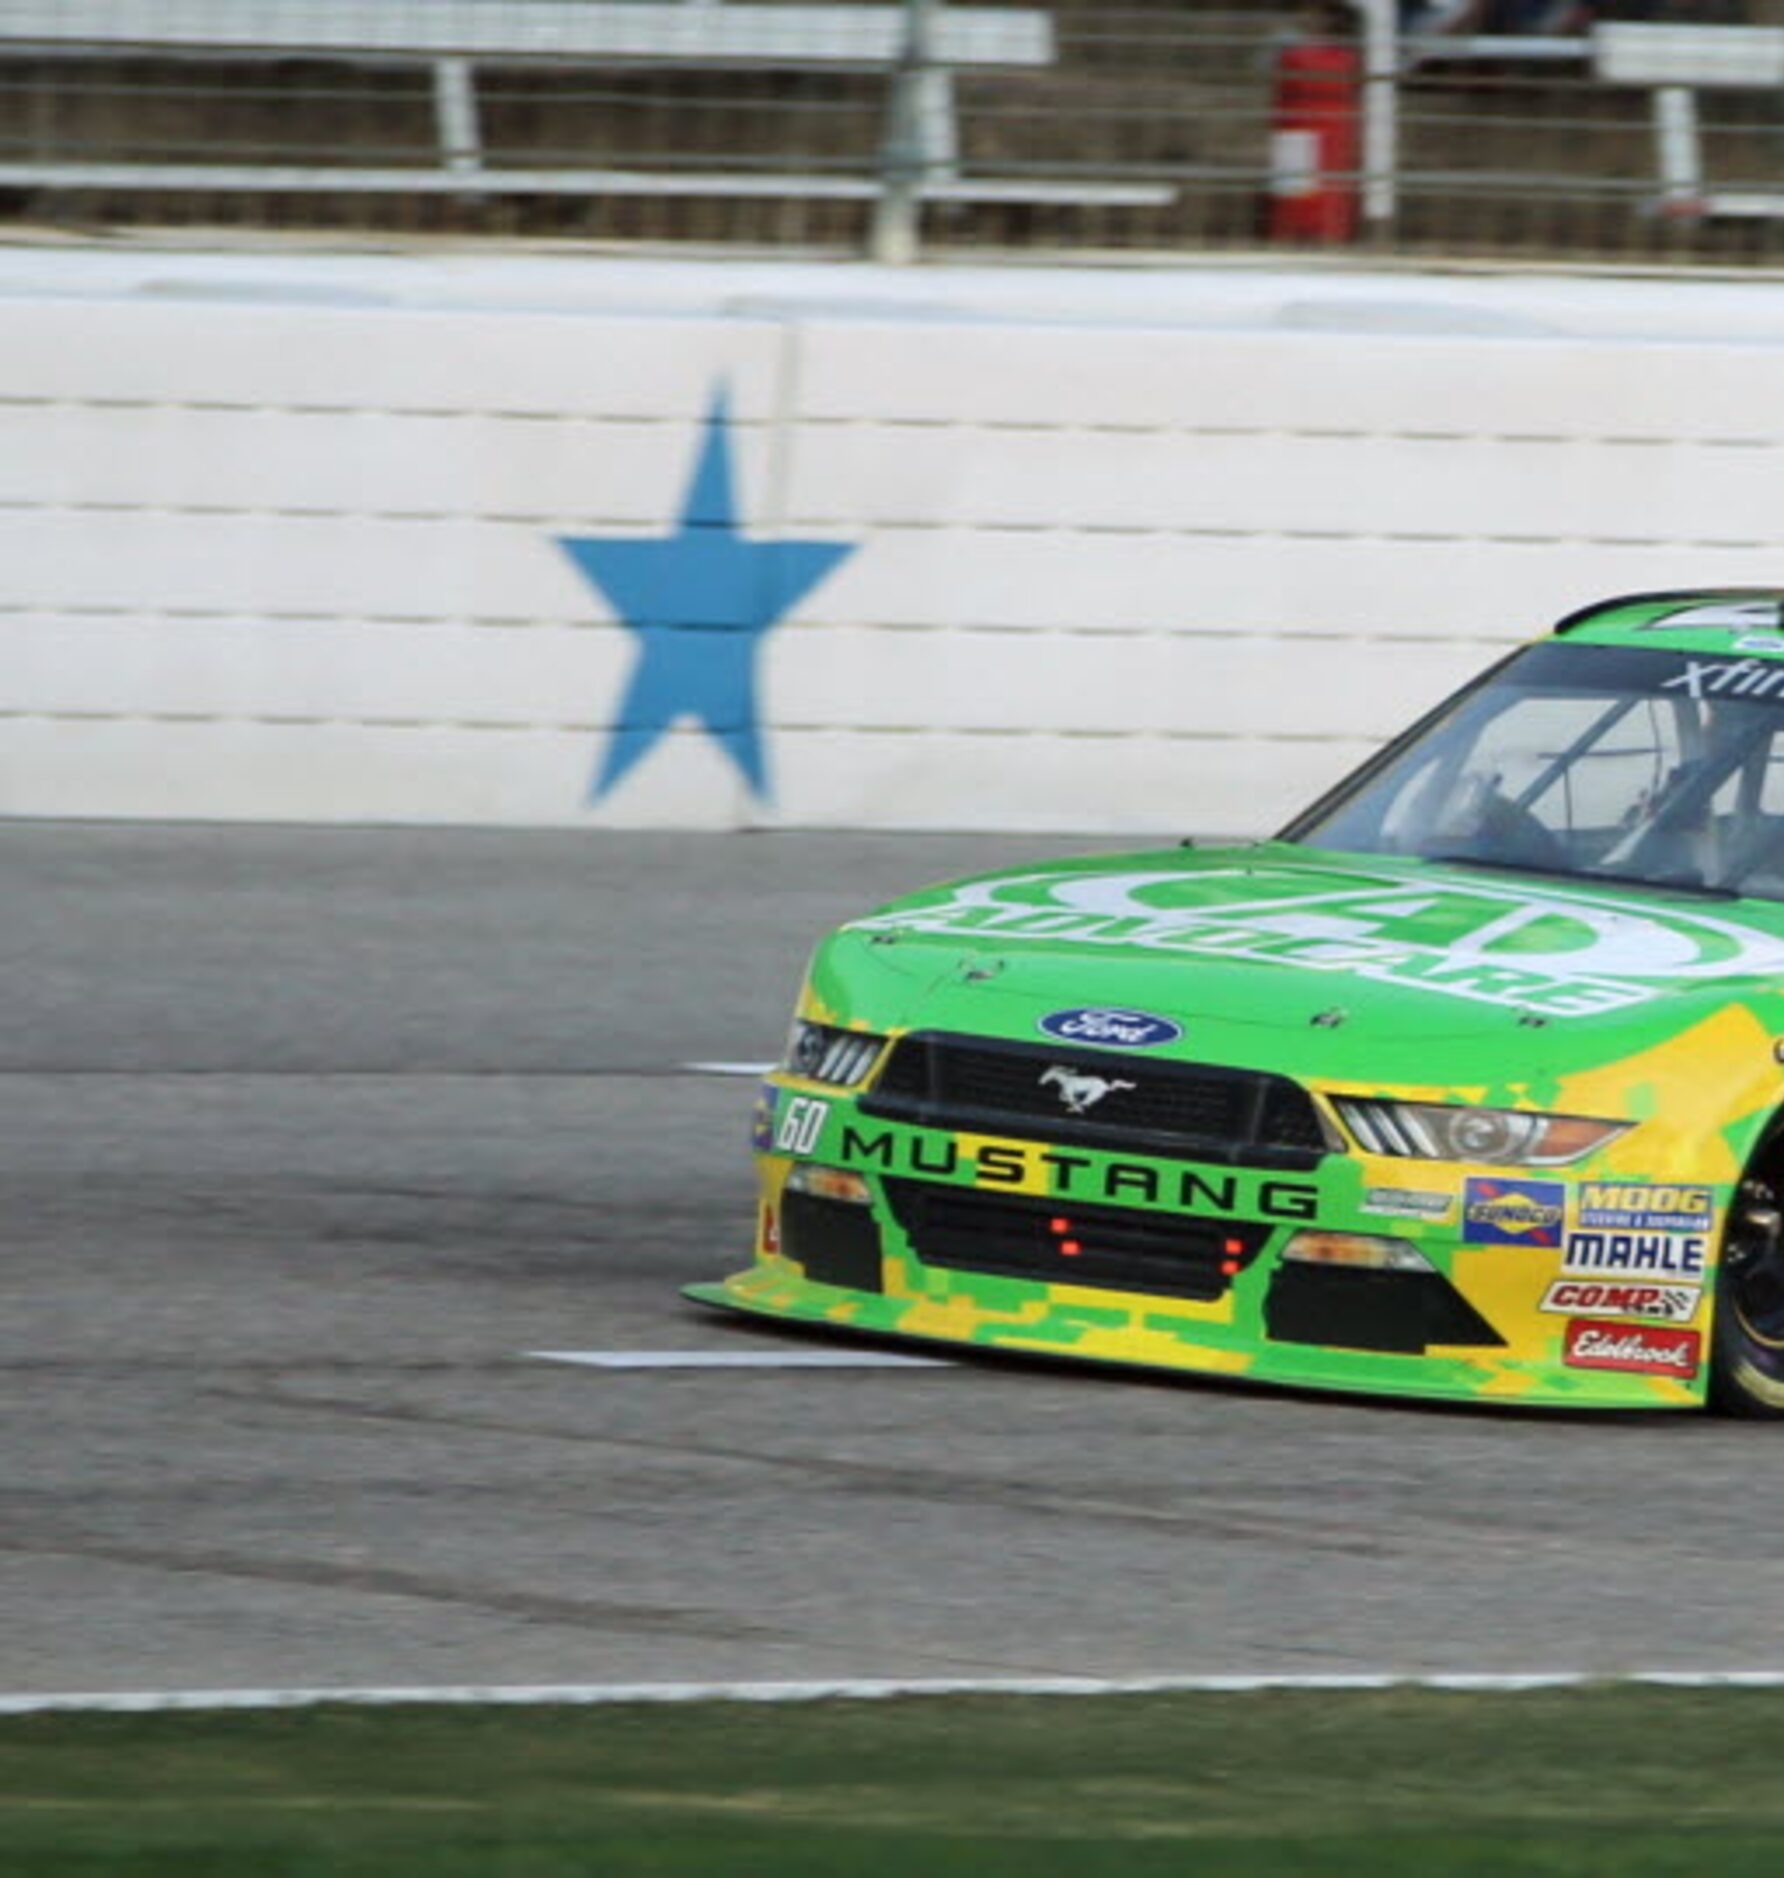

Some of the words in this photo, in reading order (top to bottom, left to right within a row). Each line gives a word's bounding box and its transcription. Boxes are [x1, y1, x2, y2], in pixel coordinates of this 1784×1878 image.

[1061, 1011, 1159, 1042] Ford
[777, 1096, 830, 1155] 60
[841, 1126, 1320, 1221] MUSTANG
[1467, 1202, 1564, 1227] SUNOCO
[1579, 1185, 1709, 1214] MOOG
[1565, 1232, 1704, 1272] MAHLE
[1551, 1284, 1661, 1307] COMP
[1573, 1329, 1690, 1368] Edelbrock
